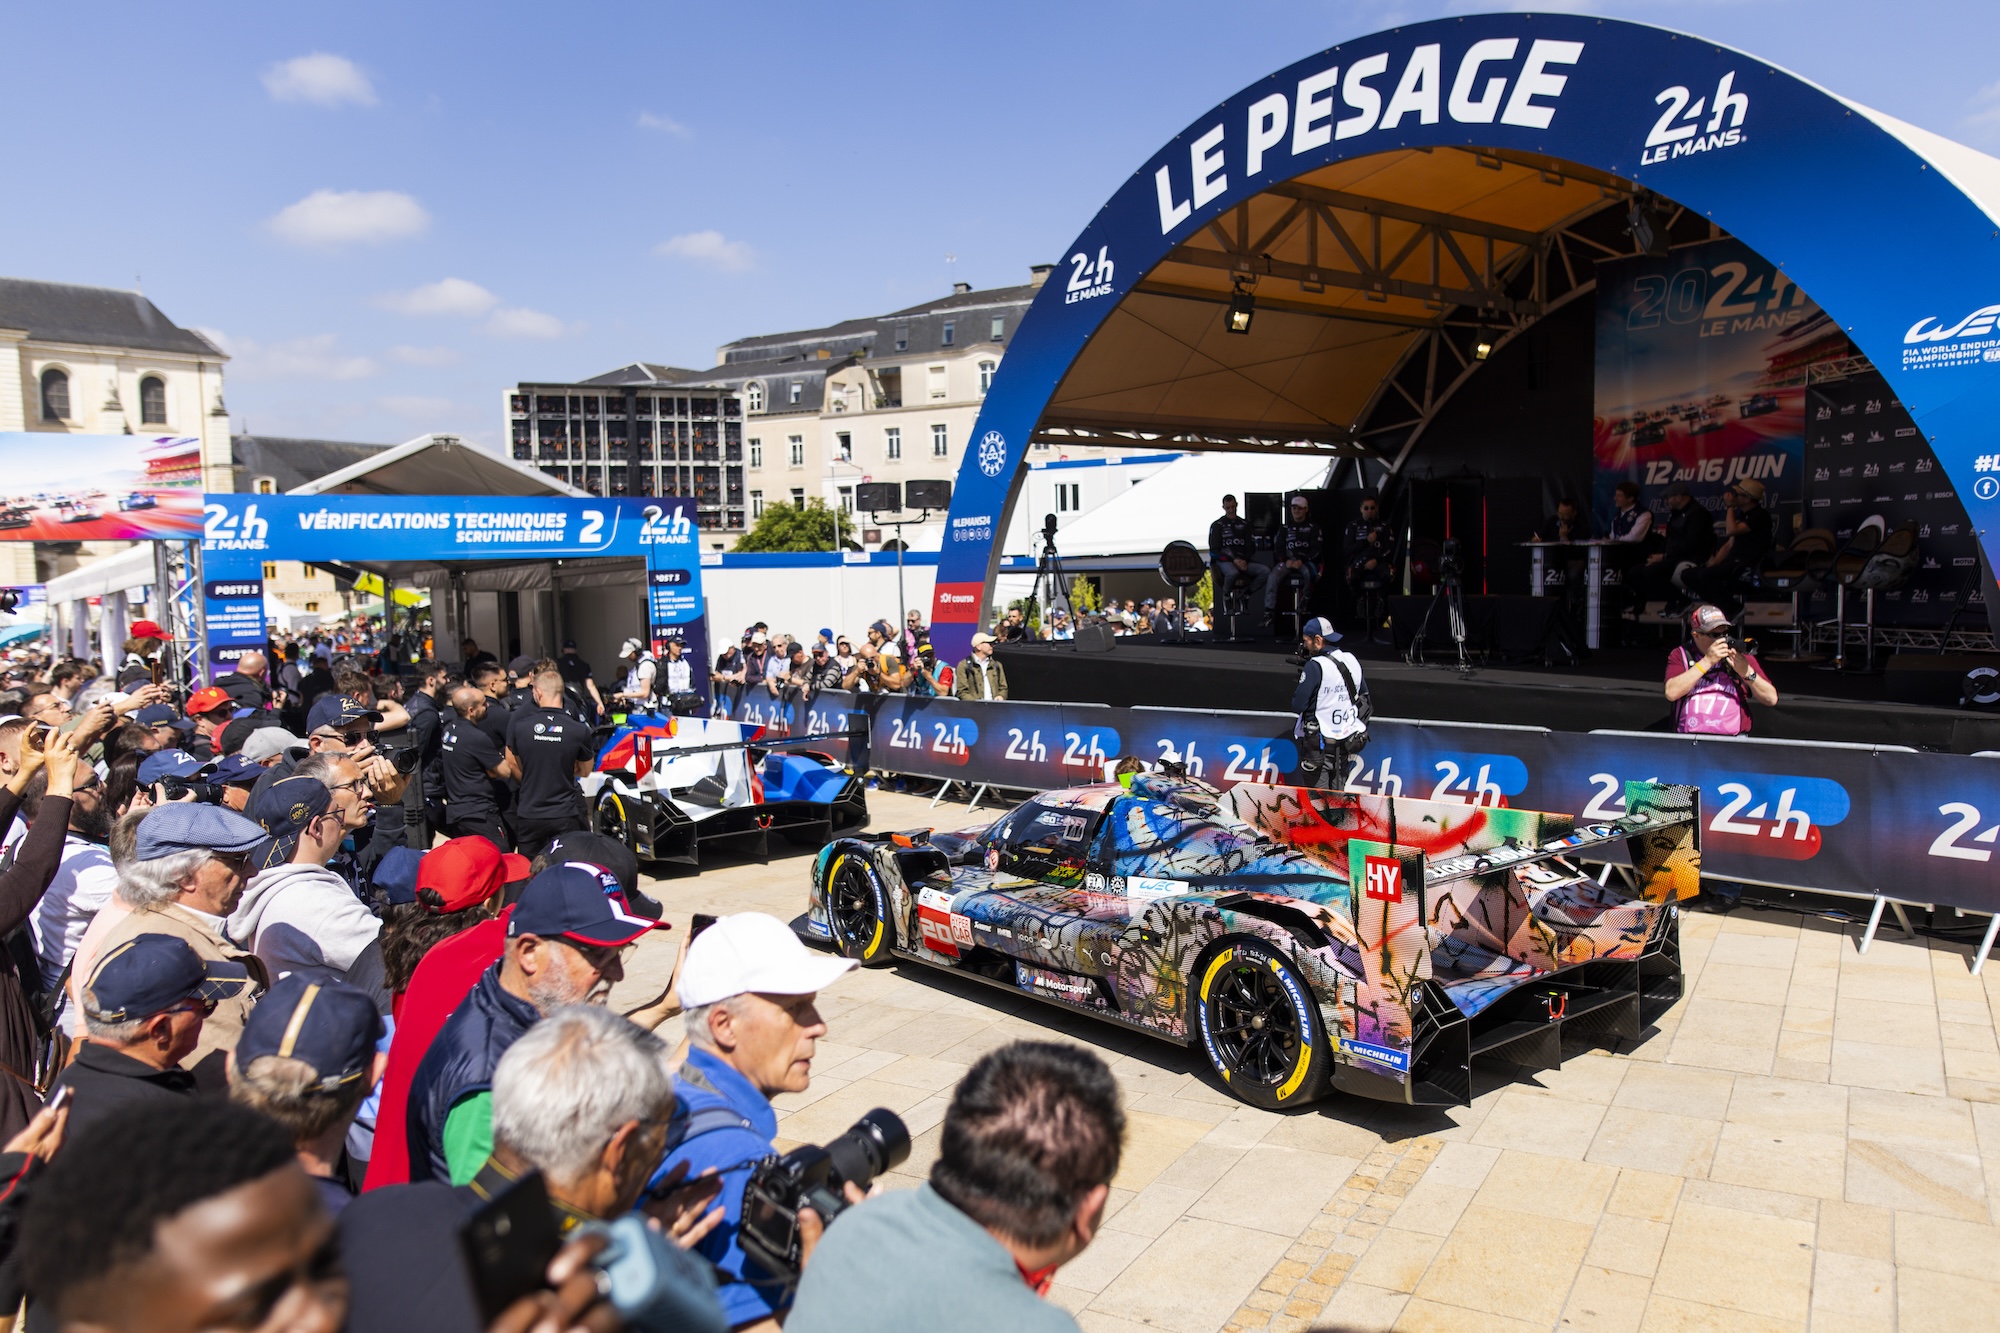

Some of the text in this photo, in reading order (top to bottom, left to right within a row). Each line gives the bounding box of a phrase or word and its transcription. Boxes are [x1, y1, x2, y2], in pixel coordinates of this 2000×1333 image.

[1155, 38, 1585, 235] LE PESAGE
[1641, 129, 1741, 166] LE MANS
[1065, 283, 1111, 304] LE MANS
[1699, 310, 1801, 338] LE MANS
[1902, 350, 1981, 364] CHAMPIONSHIP
[1903, 349, 1919, 357] FIA
[1921, 344, 1958, 355] WORLD
[1913, 358, 1980, 370] PARTNERSHIP
[1645, 453, 1787, 486] 12 AU 16 JUIN
[298, 508, 567, 530] VÉRIFICATIONS TECHNIQUES
[579, 510, 604, 543] 2
[200, 539, 266, 550] LE MANS
[456, 529, 564, 543] SCRUTINEERING
[655, 535, 690, 544] MANS
[675, 573, 680, 581] 3
[215, 585, 259, 595] POSTE 3
[1087, 876, 1102, 892] FIA
[1140, 881, 1175, 892] WEC
[1367, 862, 1399, 895] HY
[871, 876, 883, 918] MICHELIN
[951, 915, 970, 928] HYPER
[920, 917, 955, 945] 20
[953, 926, 972, 945] CAR
[1046, 979, 1092, 994] Motorsport
[1284, 977, 1310, 1039] MICHELIN
[1200, 1004, 1219, 1063] MICHELIN
[1353, 1046, 1402, 1064] MICHELIN
